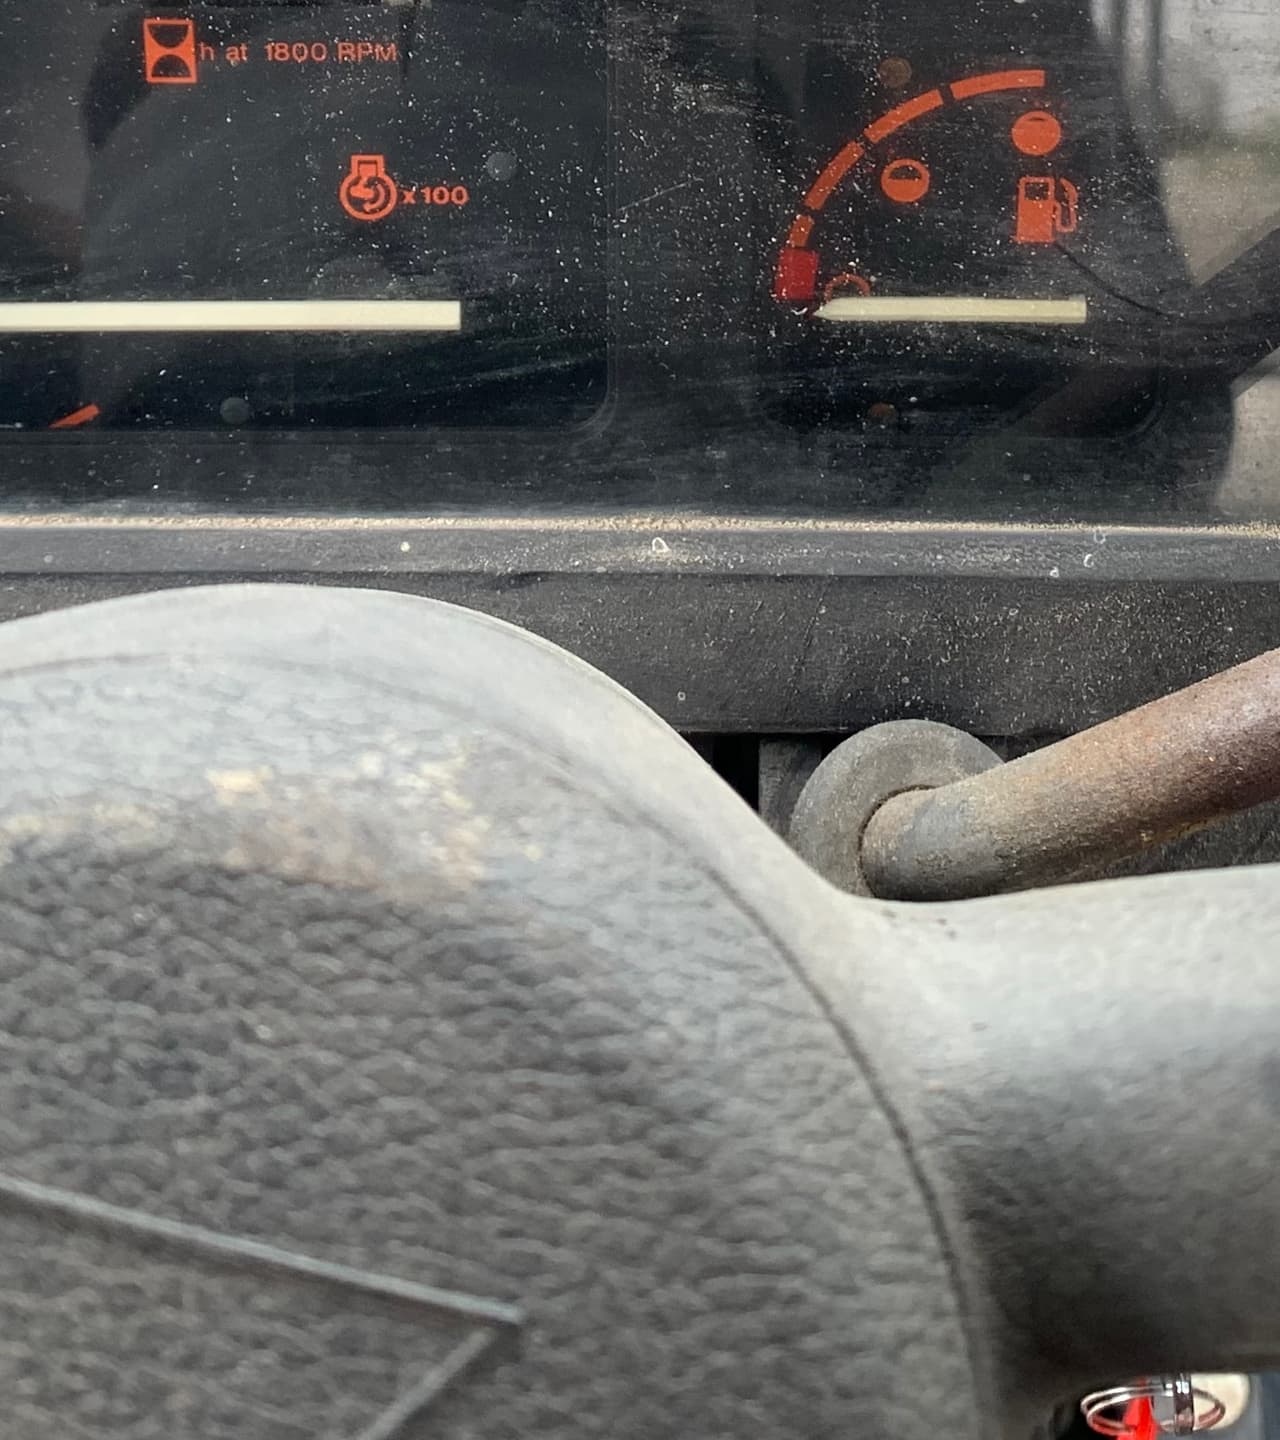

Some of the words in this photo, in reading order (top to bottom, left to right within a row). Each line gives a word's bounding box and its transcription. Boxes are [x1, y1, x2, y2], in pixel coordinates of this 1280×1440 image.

[201, 42, 214, 60] h
[226, 42, 248, 61] at
[265, 43, 326, 60] 1800
[338, 43, 398, 60] RPM
